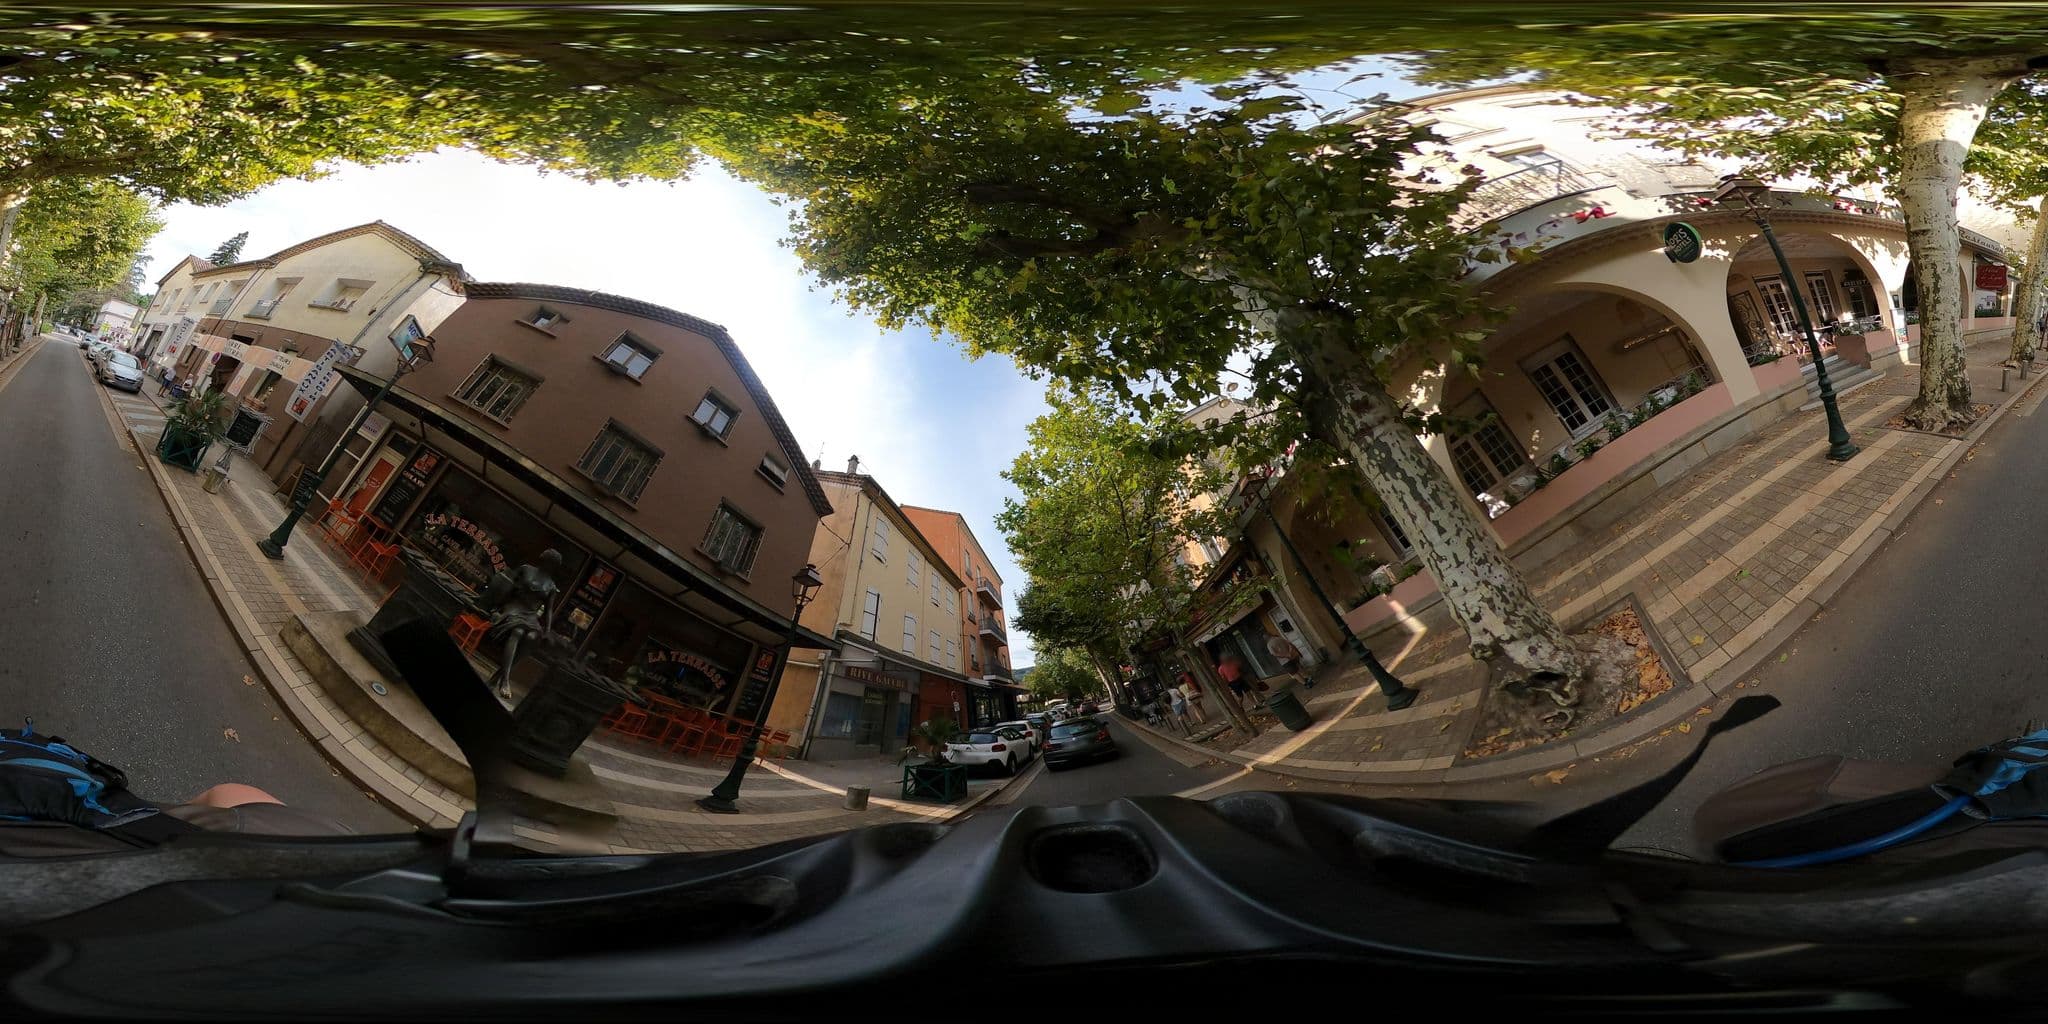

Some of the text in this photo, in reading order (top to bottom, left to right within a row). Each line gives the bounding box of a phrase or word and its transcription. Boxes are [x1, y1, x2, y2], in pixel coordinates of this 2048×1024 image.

[1958, 229, 2004, 253] Restauran
[299, 348, 337, 393] ARTISANAUX
[424, 512, 448, 526] LA
[449, 515, 508, 574] TERRASSE
[647, 650, 668, 664] LA
[669, 650, 727, 690] TERRASSE
[850, 666, 873, 683] RIVE
